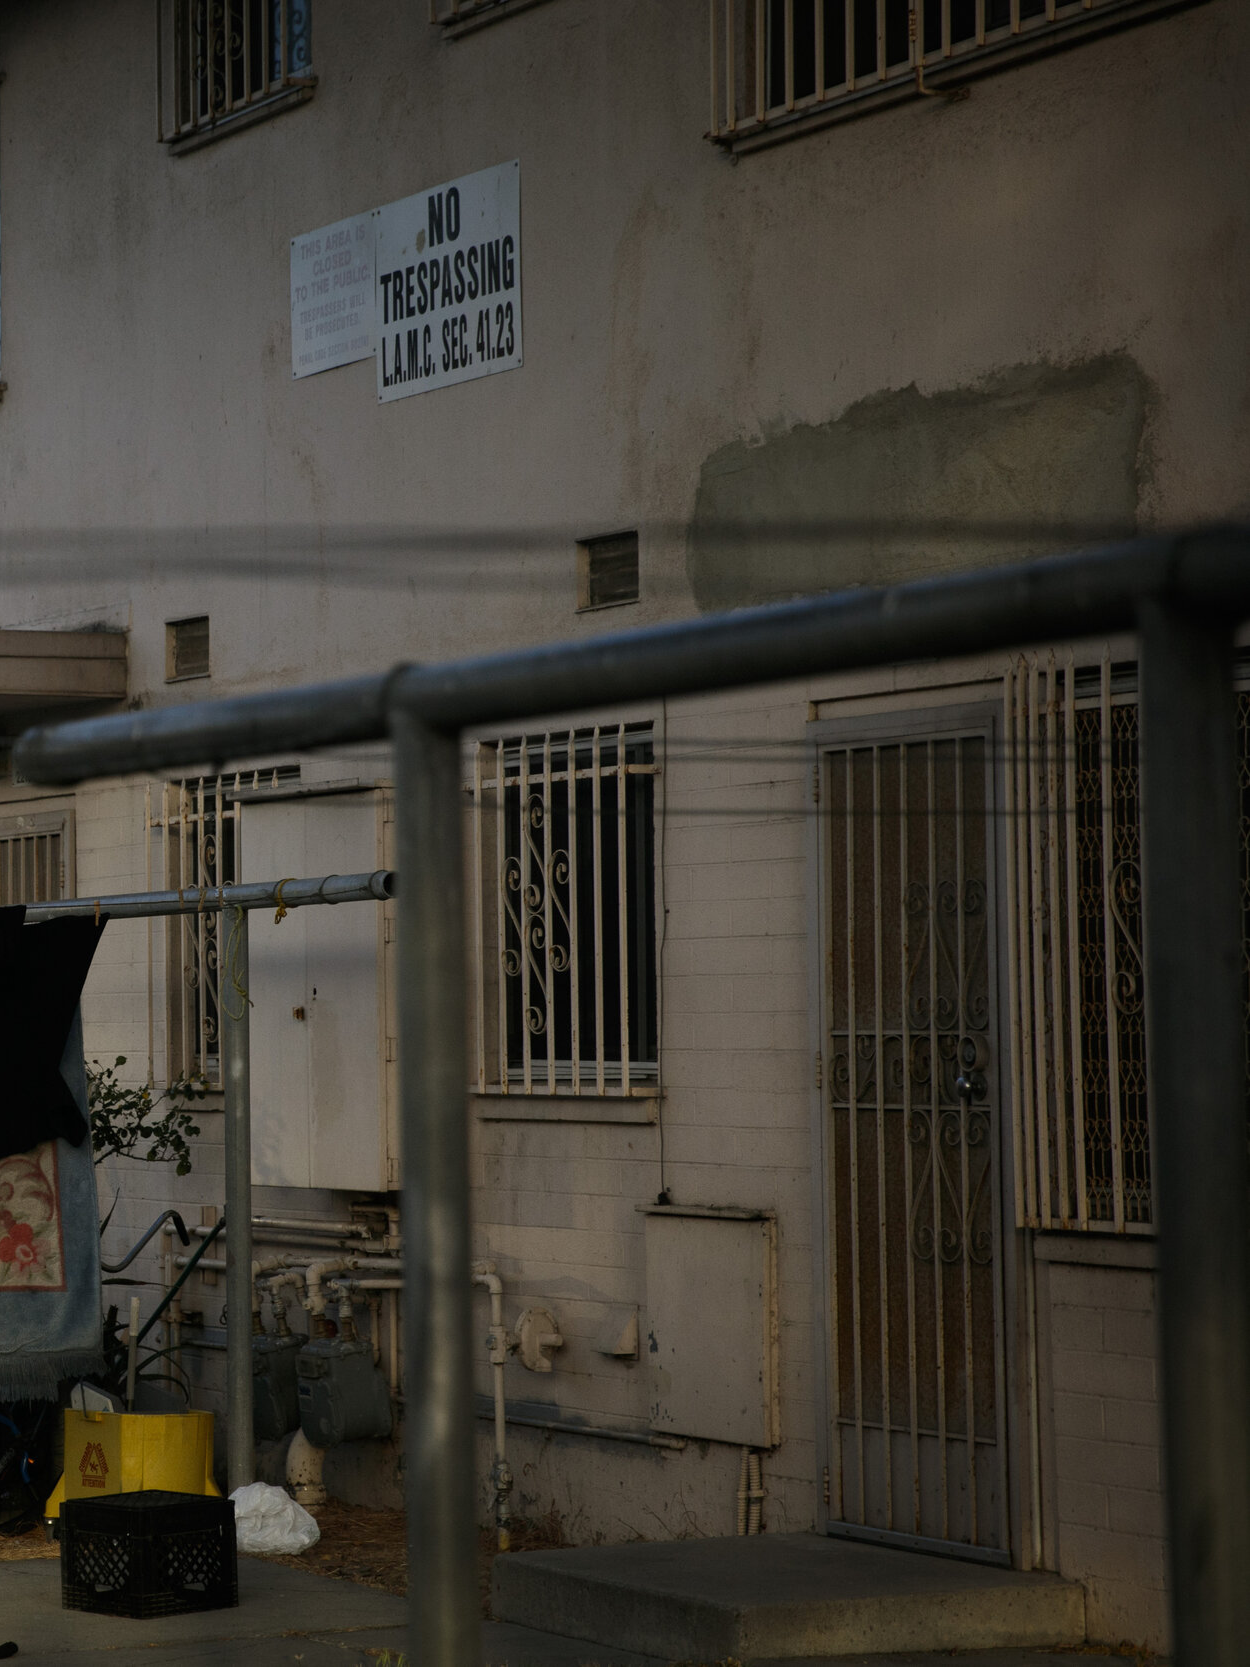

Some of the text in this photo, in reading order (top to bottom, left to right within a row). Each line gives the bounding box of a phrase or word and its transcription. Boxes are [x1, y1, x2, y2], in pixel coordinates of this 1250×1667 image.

[428, 186, 461, 248] NO
[301, 224, 366, 260] THIS AREA IS
[313, 250, 352, 275] CLOSED
[380, 235, 515, 325] TRESPASSING
[295, 264, 371, 303] TO THE PUBLIC.
[300, 292, 367, 324] TRESPASSERS WILL
[304, 326, 314, 341] BE
[382, 301, 515, 387] L.A.M.C. SEC. 41.23
